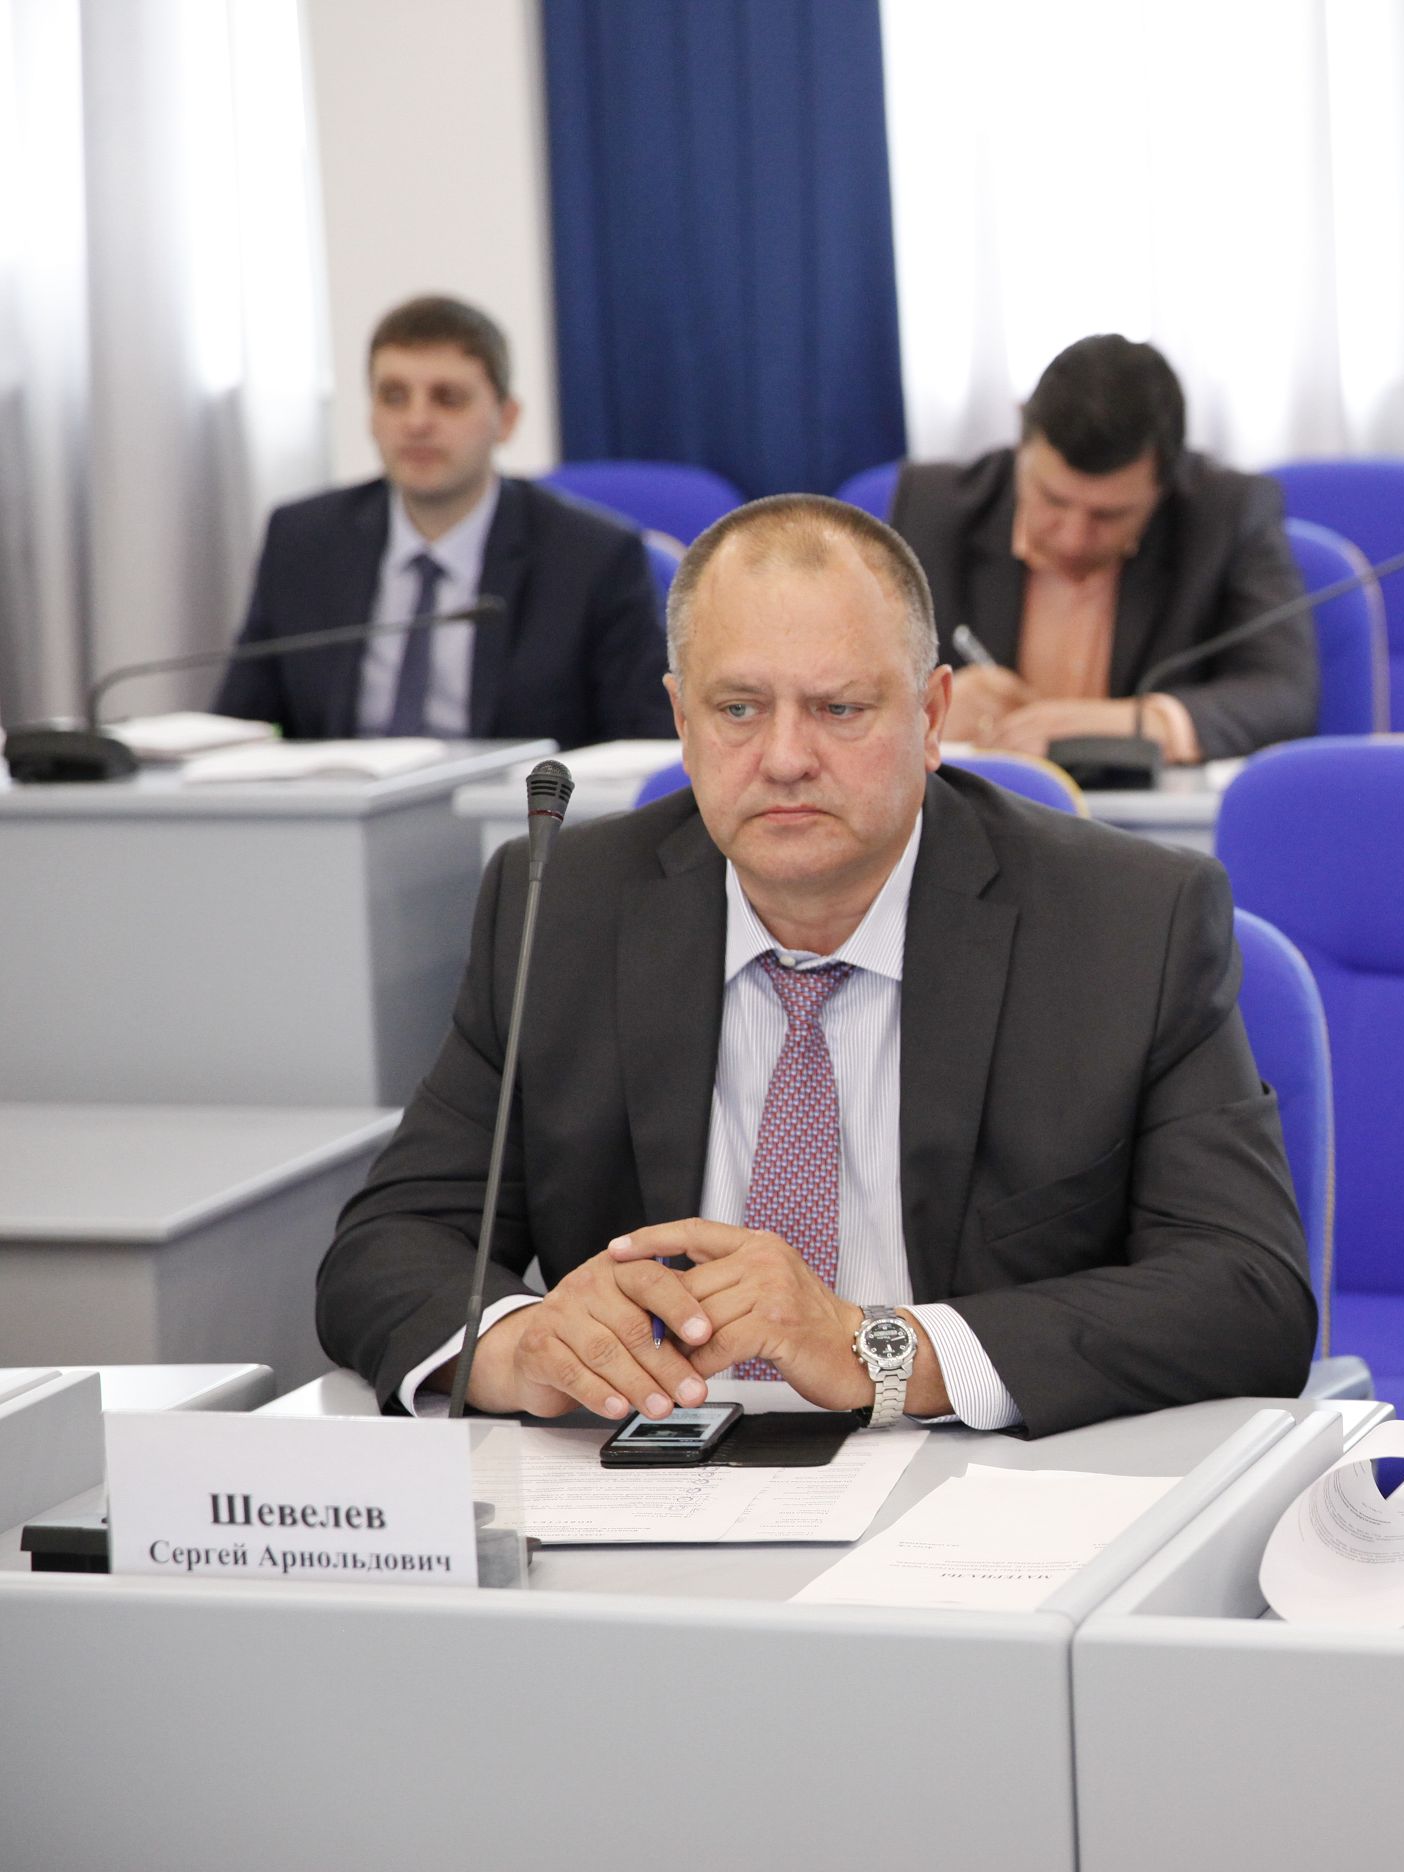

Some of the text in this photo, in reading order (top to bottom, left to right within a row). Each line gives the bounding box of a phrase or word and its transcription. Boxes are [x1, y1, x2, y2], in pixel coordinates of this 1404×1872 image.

[208, 1492, 388, 1531] Шевелев
[149, 1539, 453, 1574] Сергей Арнольдович
